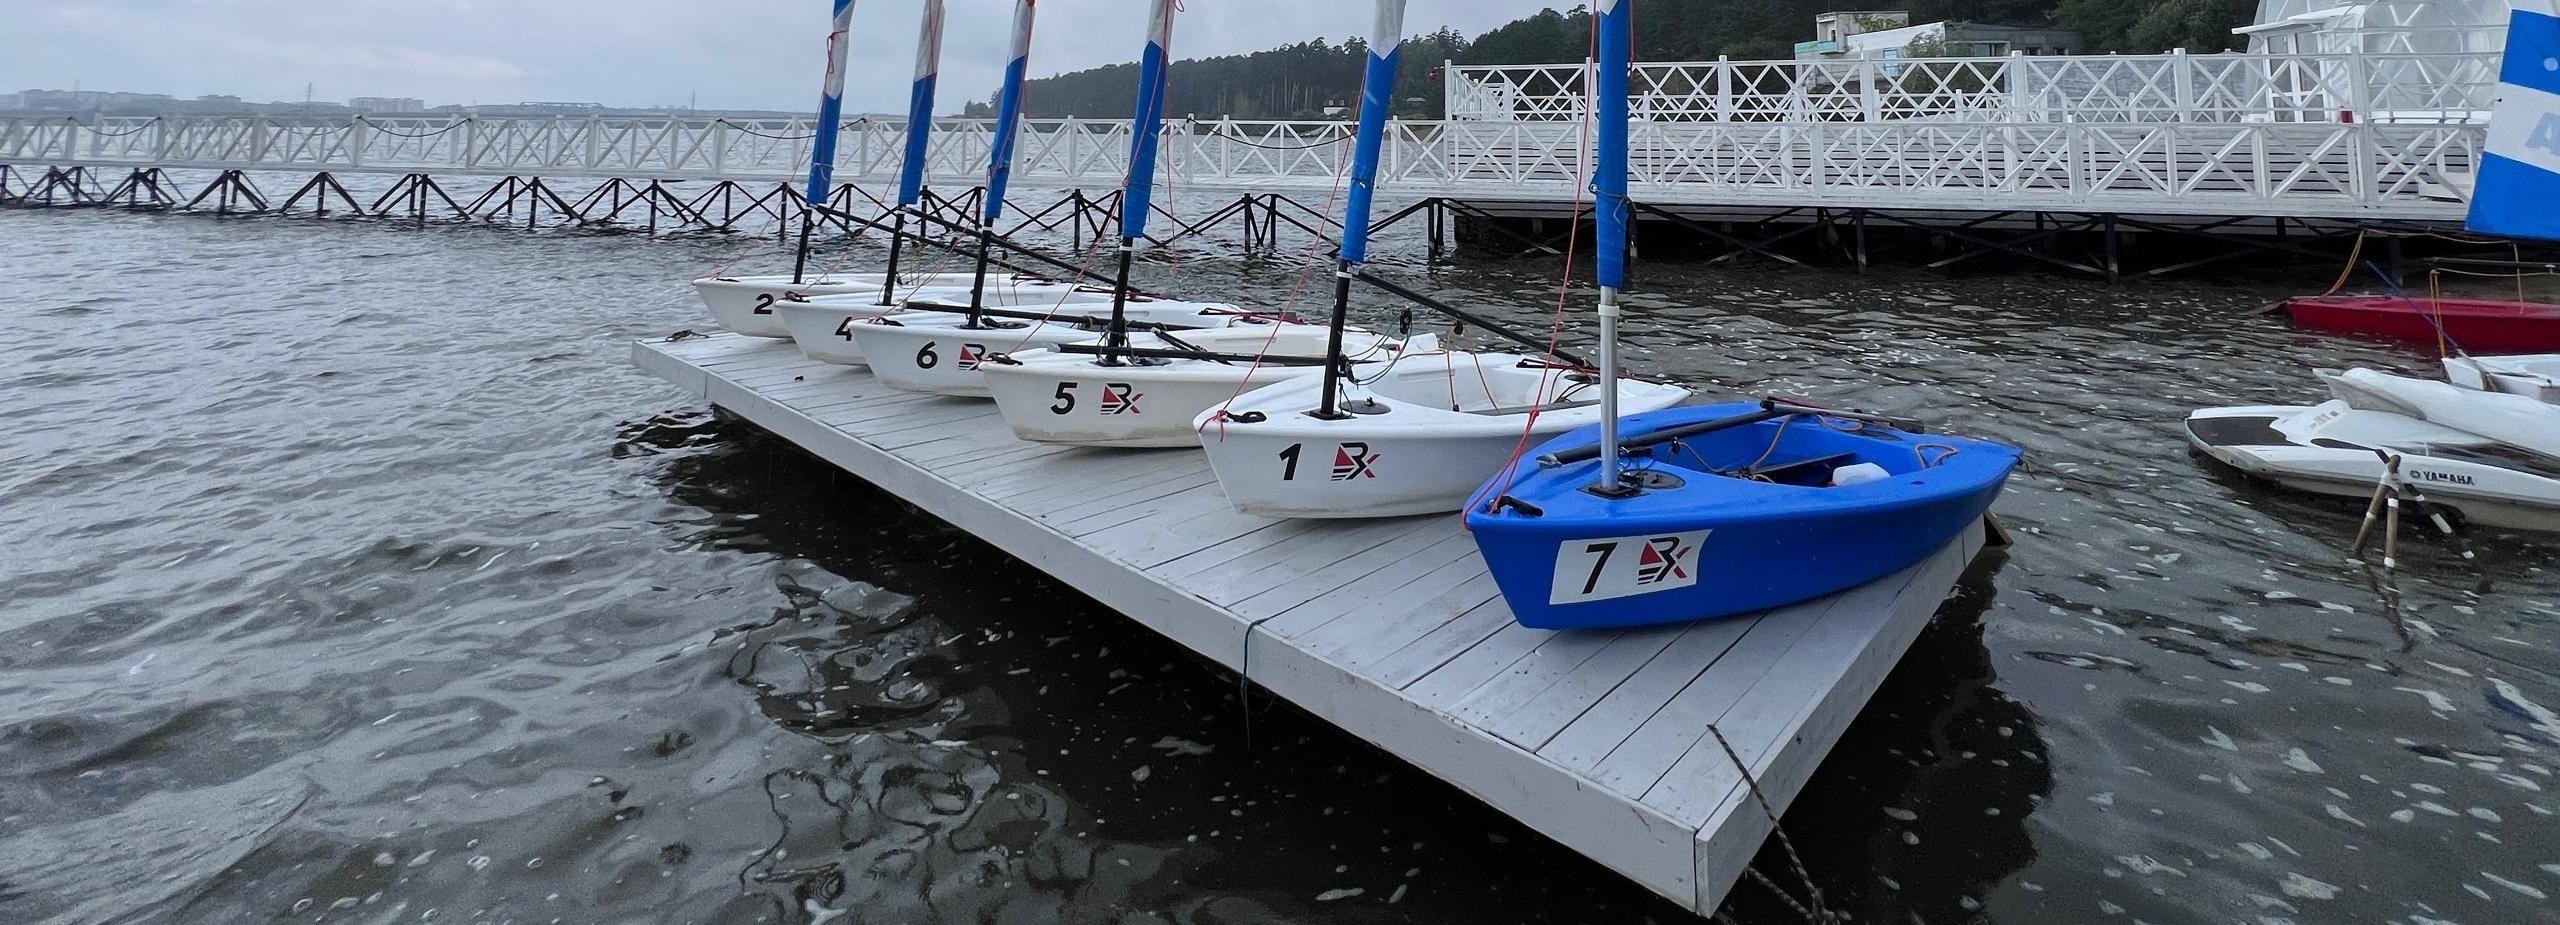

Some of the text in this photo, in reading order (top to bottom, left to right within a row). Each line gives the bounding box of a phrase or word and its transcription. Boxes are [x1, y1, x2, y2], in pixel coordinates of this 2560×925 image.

[753, 293, 774, 315] 2
[835, 316, 853, 342] 4
[916, 341, 938, 369] 6
[1050, 382, 1078, 415] 5
[1279, 443, 1302, 480] 1
[2423, 471, 2475, 485] YAMAHA
[1582, 542, 1618, 594] 7
